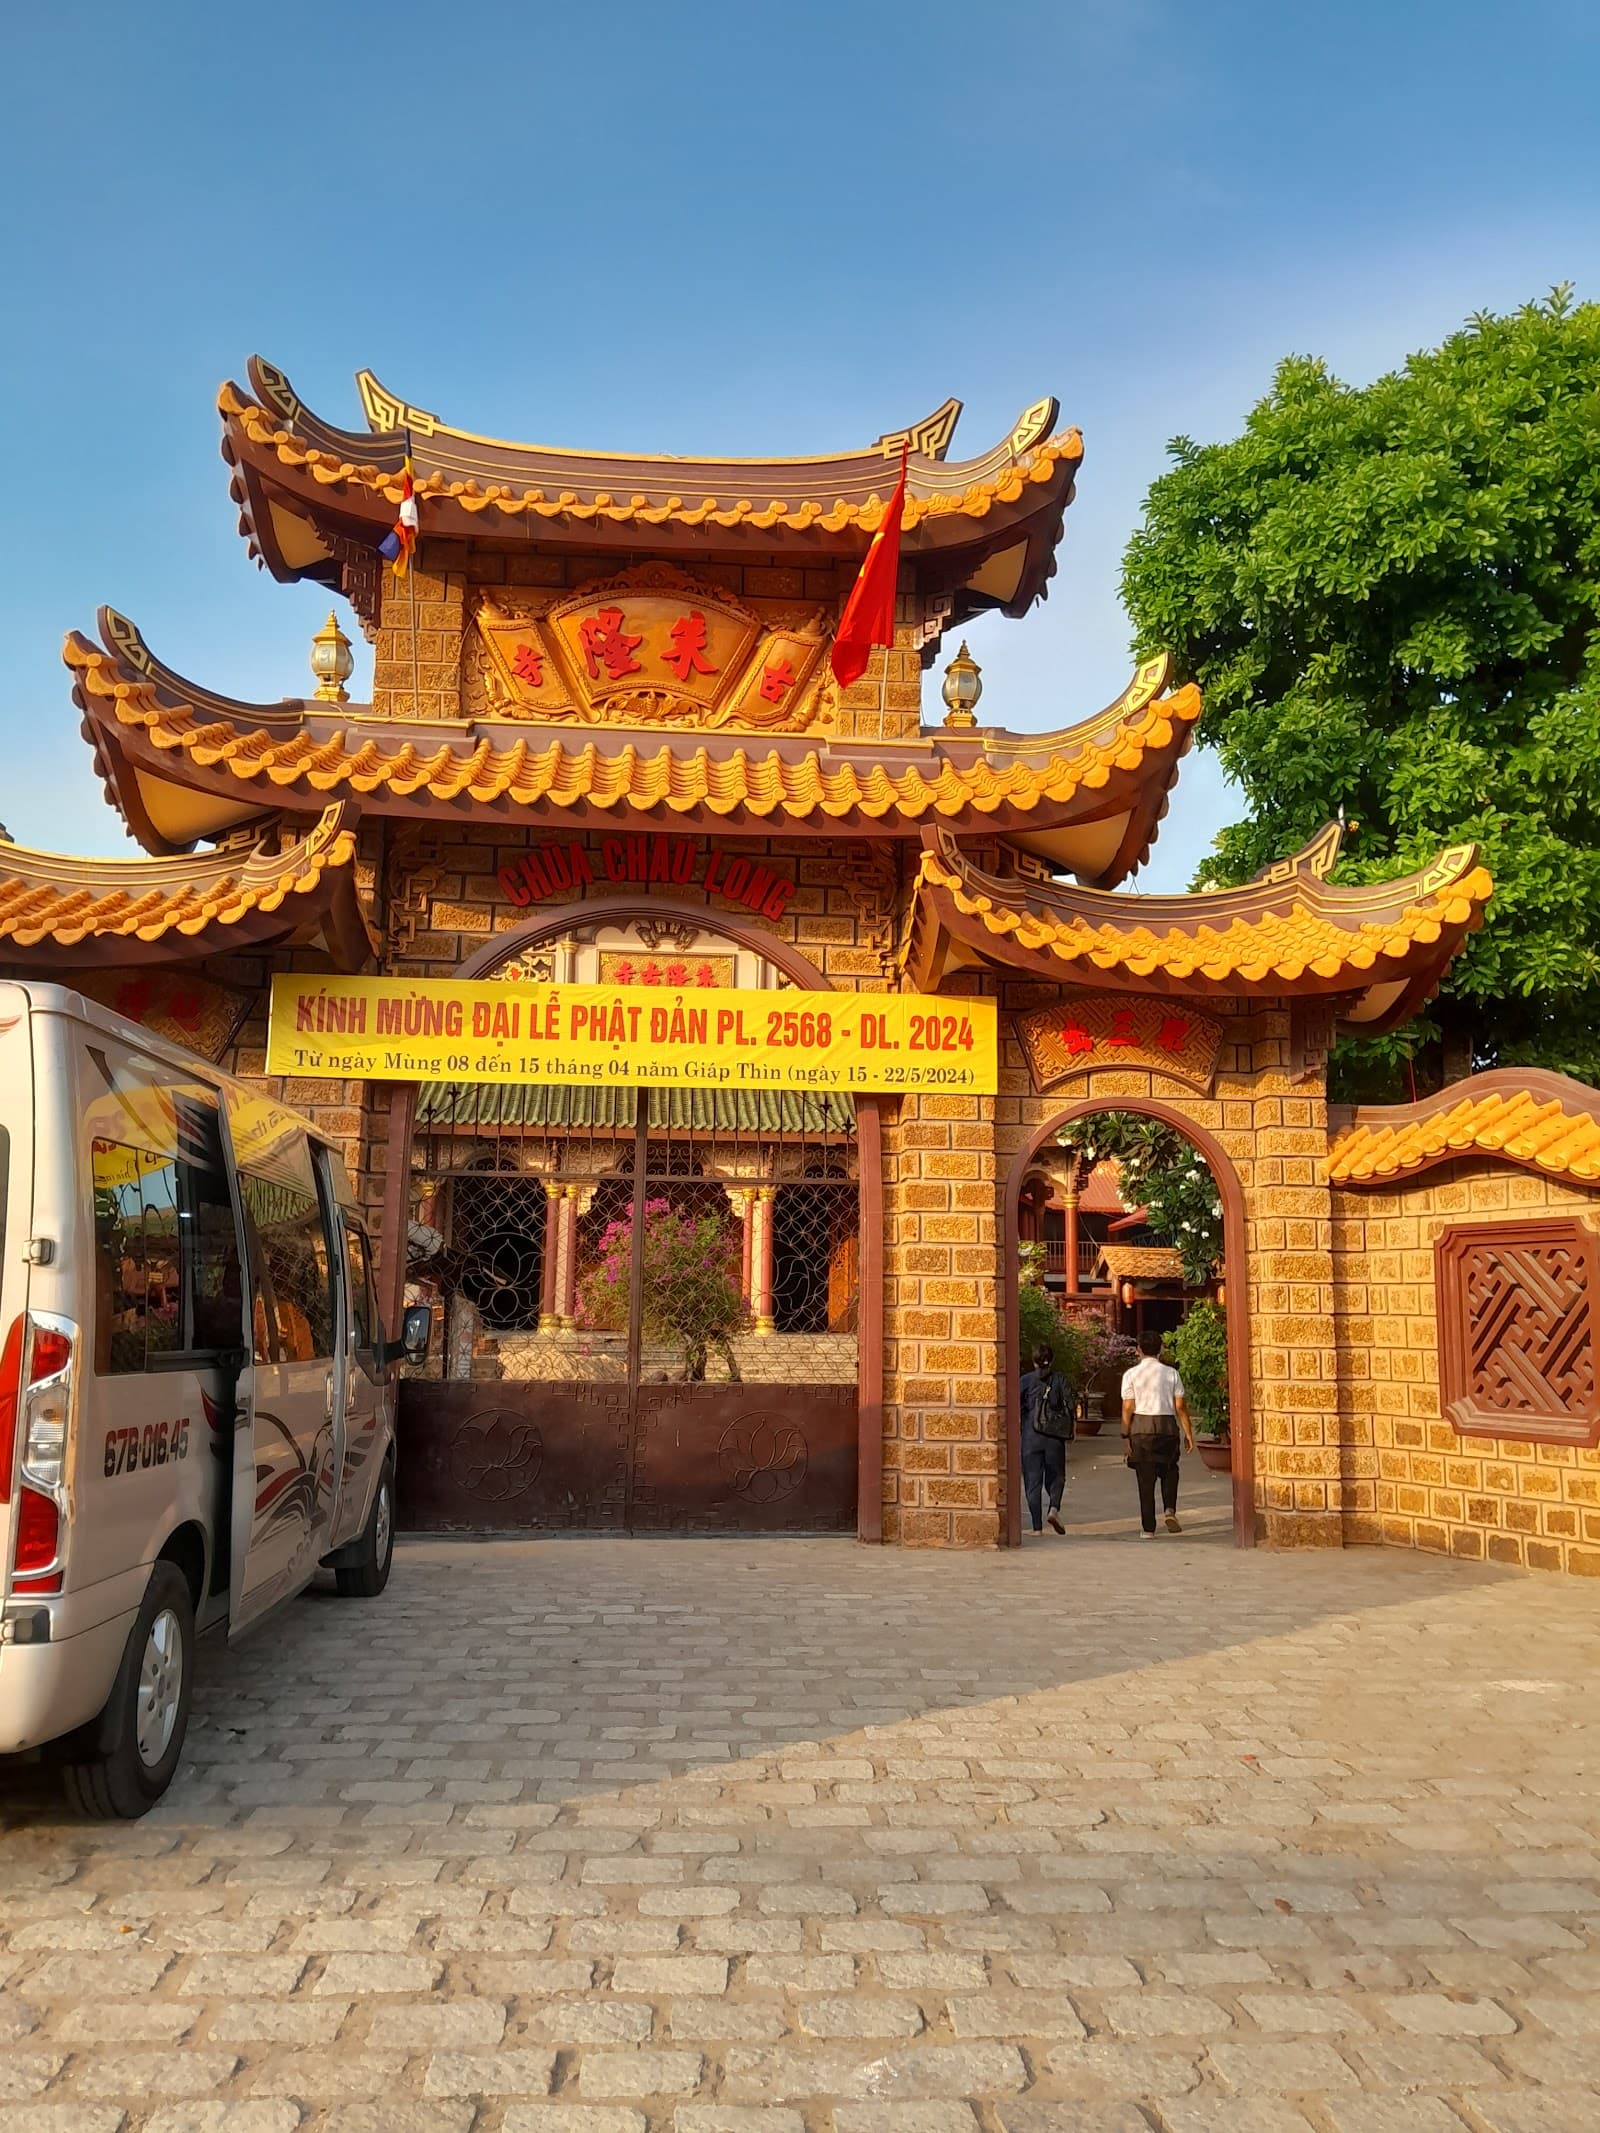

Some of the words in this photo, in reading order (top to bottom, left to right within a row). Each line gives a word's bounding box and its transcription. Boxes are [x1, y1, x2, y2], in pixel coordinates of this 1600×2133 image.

[512, 645, 544, 687] 寺
[760, 661, 795, 703] 古
[497, 839, 594, 907] CHÙA
[703, 849, 796, 922] LONG
[296, 987, 368, 1034] KÍNH
[376, 991, 463, 1037] MỪNG
[472, 1001, 520, 1047] ĐẠI
[529, 990, 561, 1040] LỄ
[570, 998, 642, 1050] PHẬT
[650, 995, 708, 1044] ĐẢN
[717, 1009, 757, 1046] PL.
[766, 1011, 832, 1048] 2568
[860, 1013, 899, 1050] DL.
[909, 1015, 975, 1052] 2024
[294, 1049, 323, 1067] Từ
[328, 1052, 377, 1072] ngày
[384, 1052, 442, 1074] Mùng
[447, 1055, 469, 1072] 08
[475, 1054, 511, 1073] đến
[519, 1057, 540, 1074] 15
[545, 1058, 603, 1079] tháng
[608, 1059, 630, 1076] 04
[636, 1061, 678, 1077] năm
[684, 1061, 730, 1082] Giáp
[737, 1063, 781, 1079] Thìn
[788, 1065, 840, 1084] (ngày
[848, 1066, 867, 1082] 15
[884, 1067, 974, 1086] 22/5/2024)
